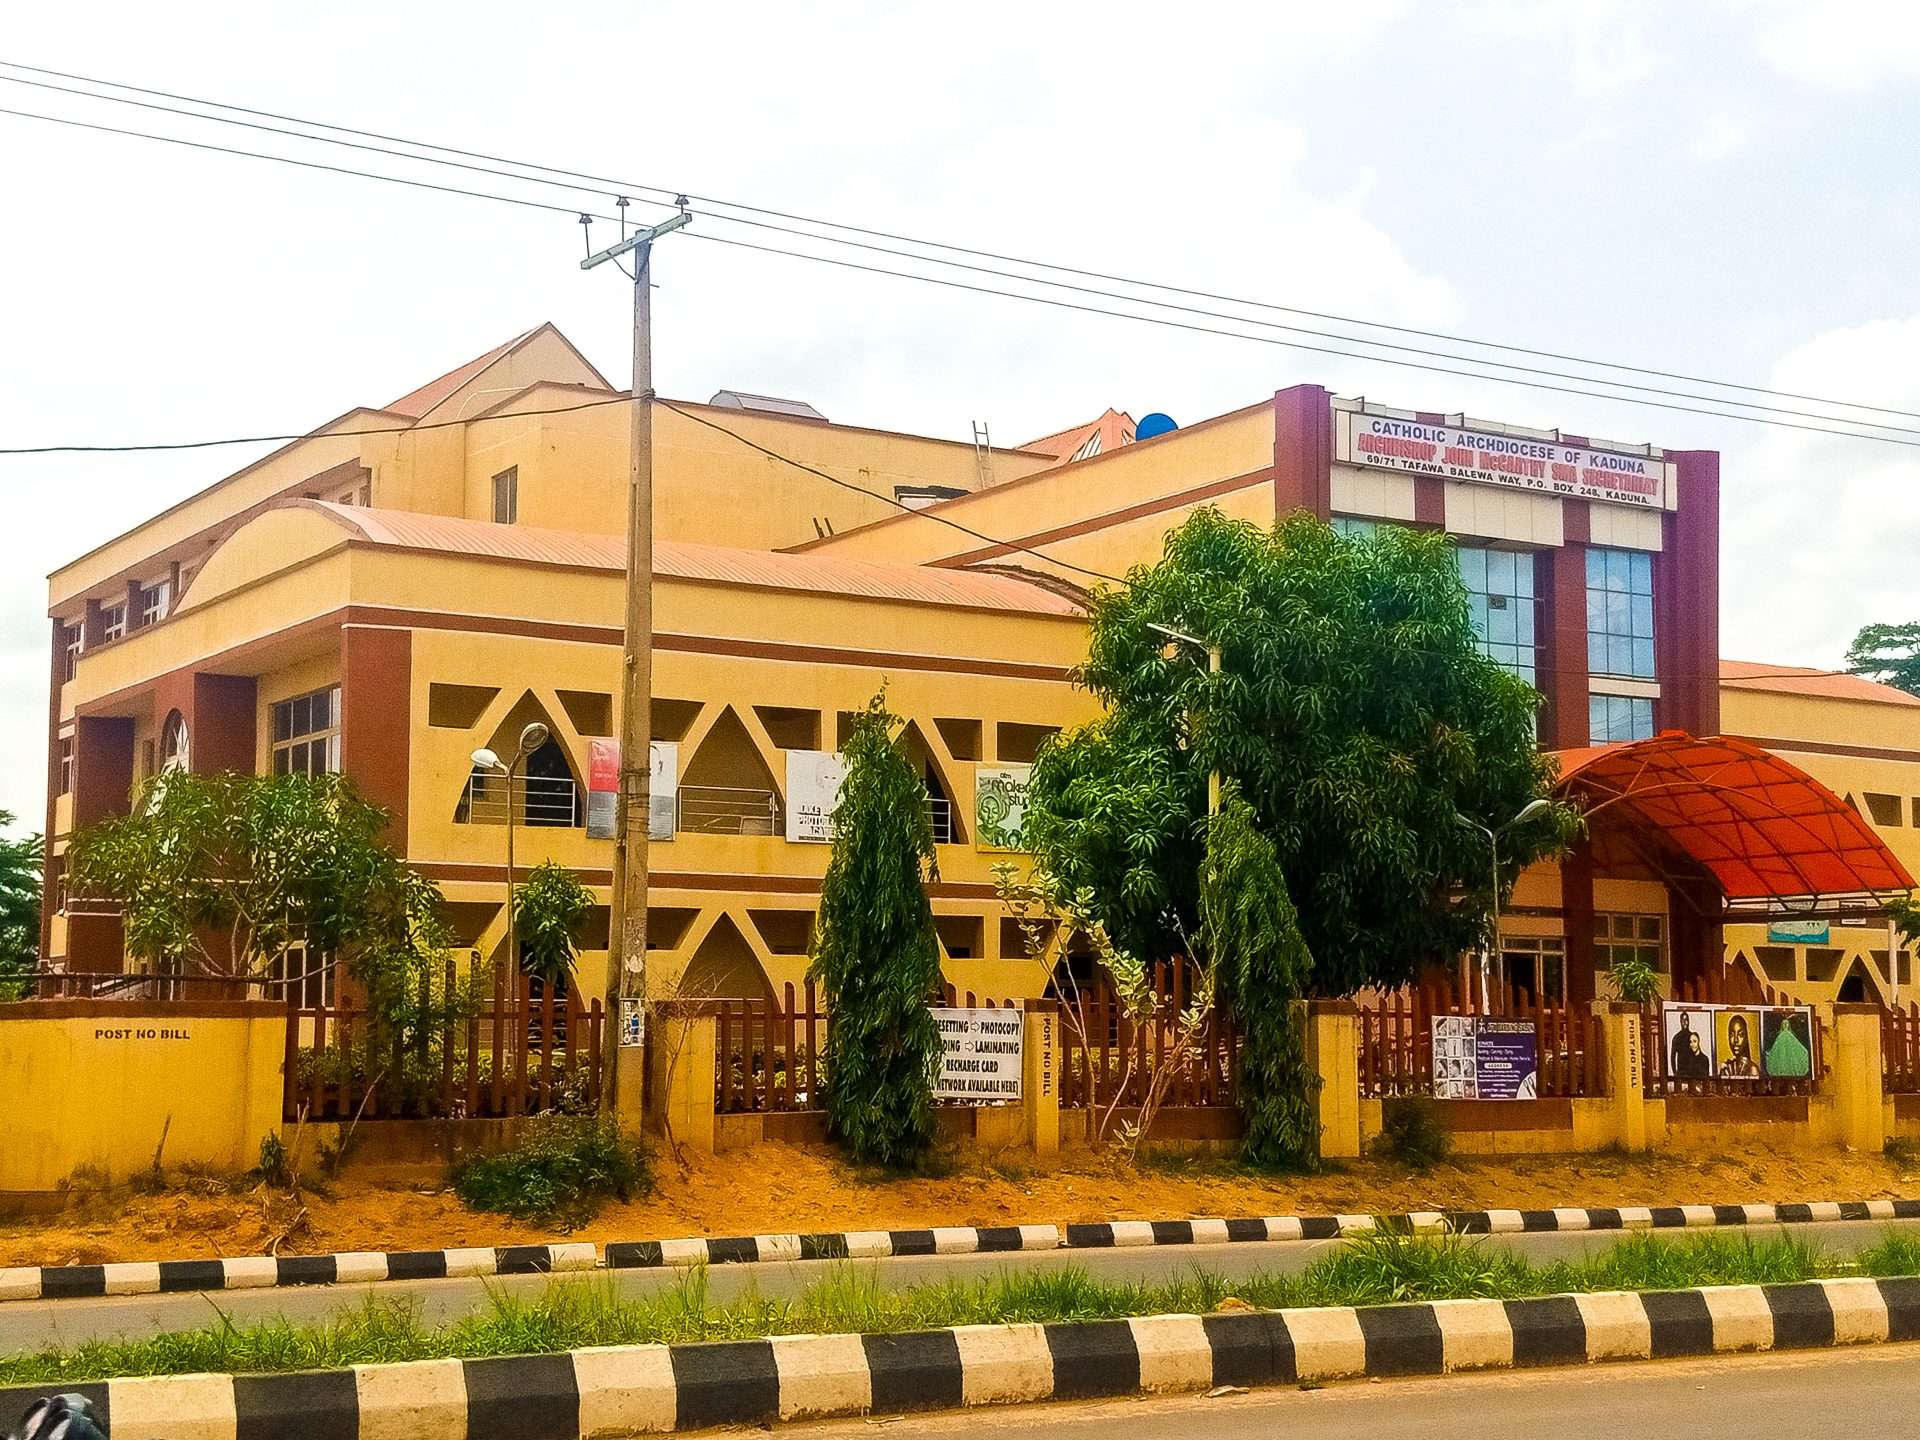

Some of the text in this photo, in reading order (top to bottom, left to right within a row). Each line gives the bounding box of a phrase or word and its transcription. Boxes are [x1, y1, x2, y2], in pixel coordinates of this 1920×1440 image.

[1372, 420, 1645, 474] CATHOLIC ARCHDIOCESE OF KADUNA
[1357, 433, 1437, 462] ARCHBISHOP
[1441, 446, 1475, 468] JOHN
[1582, 468, 1659, 496] SECRETARIAT
[1367, 454, 1396, 467] 69/71
[1401, 460, 1445, 474] TAFAWA
[1450, 467, 1494, 481] BALEWA
[1527, 479, 1547, 489] P.O.
[1553, 482, 1574, 493] BOX
[95, 1029, 190, 1039] POST NO BILL
[936, 1019, 1020, 1035] ESETTING PHOTOCOPY
[942, 1039, 1020, 1054] DING LAMINATING
[1043, 1017, 1051, 1097] POST NO BILL
[1629, 1049, 1636, 1064] NO
[945, 1059, 998, 1073] RECHARGE CARD
[937, 1078, 967, 1092] NETWORK
[967, 1078, 1000, 1093] AVAILABLE
